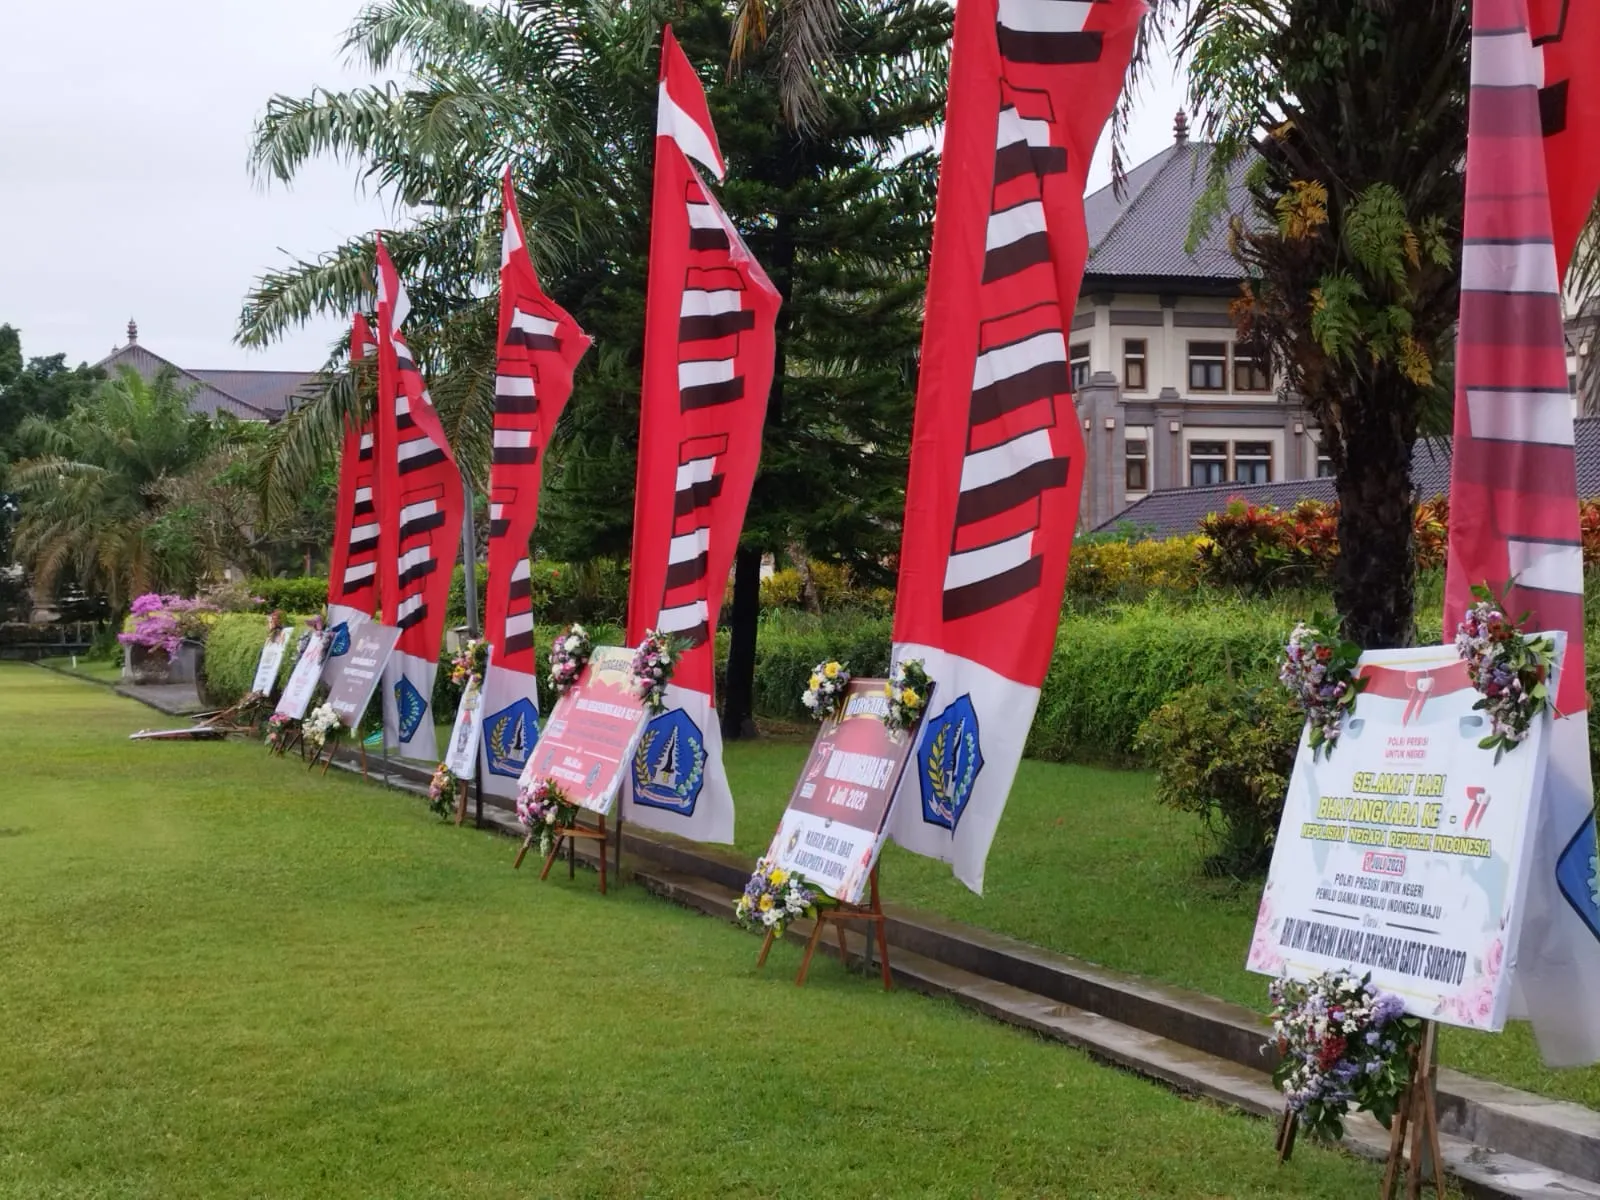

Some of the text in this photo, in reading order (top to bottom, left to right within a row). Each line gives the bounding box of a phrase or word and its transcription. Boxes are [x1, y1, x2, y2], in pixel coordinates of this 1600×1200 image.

[1353, 771, 1447, 797] SELAMAT HARI
[1317, 796, 1419, 827] BHAYANGKARA
[1421, 802, 1443, 829] KE
[1300, 822, 1492, 858] KEPOLISIAN NEGARA REPUBLIK INDONESIA
[1371, 856, 1388, 872] JULI
[1387, 858, 1404, 873] 2023
[1334, 873, 1425, 899] POLRI PRESISI UNTUK NEGERI
[1315, 887, 1443, 920] PEMILU DAMAI MENUJU INDONESIA MAJU
[1360, 932, 1401, 972] DENPASAR
[1398, 938, 1426, 978] GATOT
[1424, 944, 1467, 987] SUBROTO
